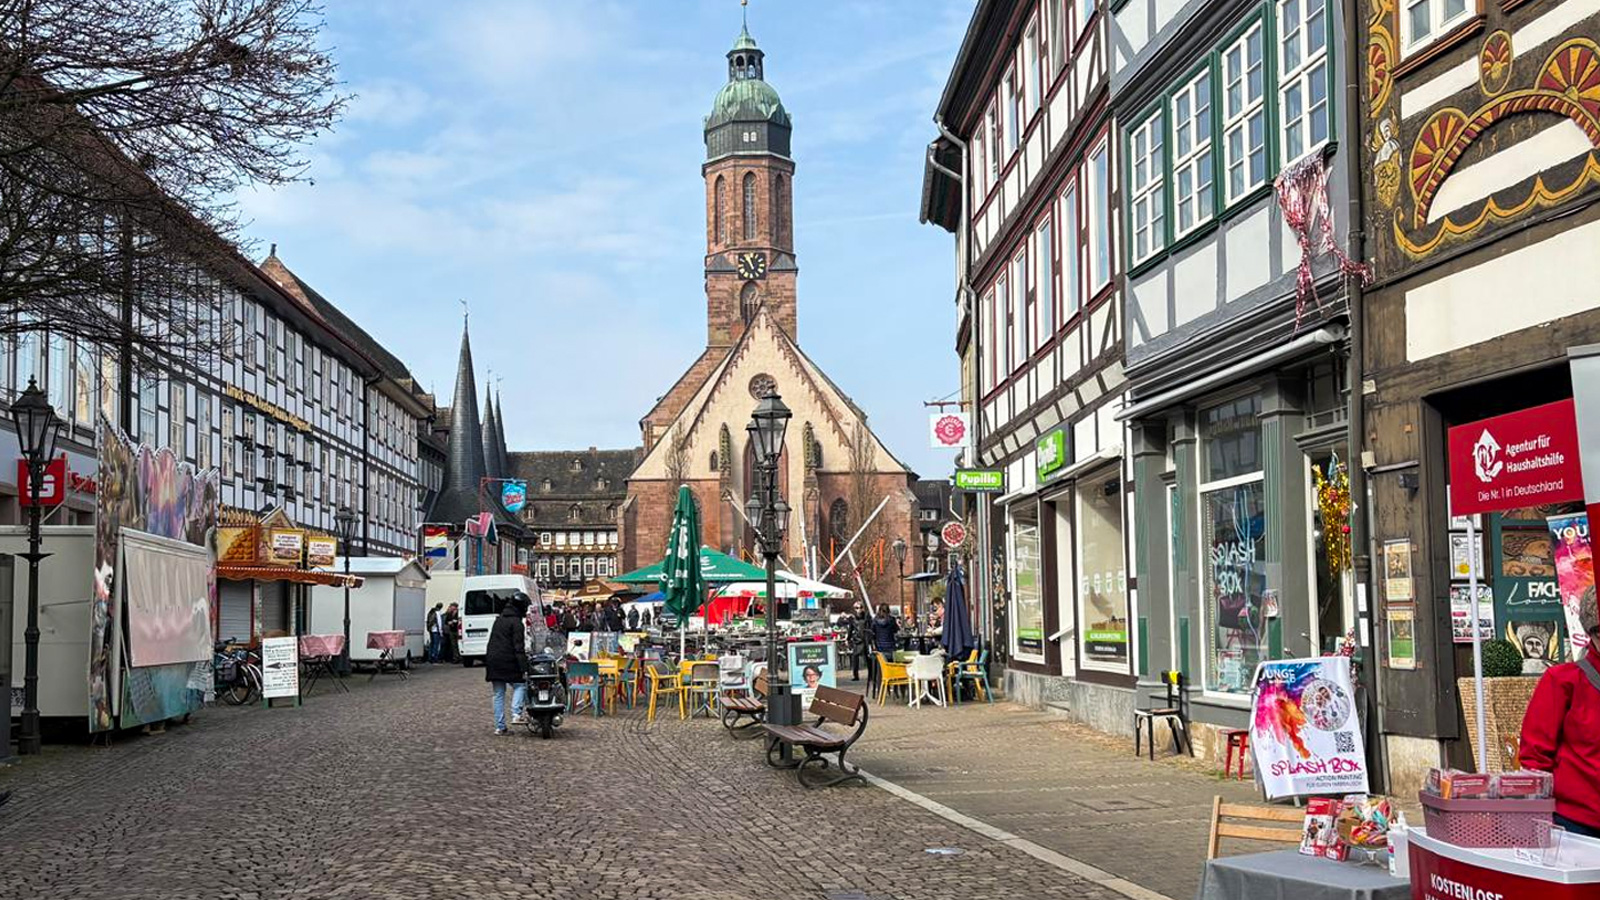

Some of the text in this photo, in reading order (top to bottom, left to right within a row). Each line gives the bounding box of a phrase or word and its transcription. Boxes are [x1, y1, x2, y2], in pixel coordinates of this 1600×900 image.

[1505, 434, 1551, 456] Agentur für
[1506, 453, 1565, 473] Haushaltshilfe
[960, 474, 997, 485] Pupille
[1478, 491, 1489, 501] Die
[1505, 487, 1513, 497] in
[1513, 479, 1564, 495] Deutschland
[1211, 539, 1256, 566] SPLASH
[1271, 757, 1362, 777] SPLASH BOX
[1315, 773, 1363, 782] ACTION PAINTING
